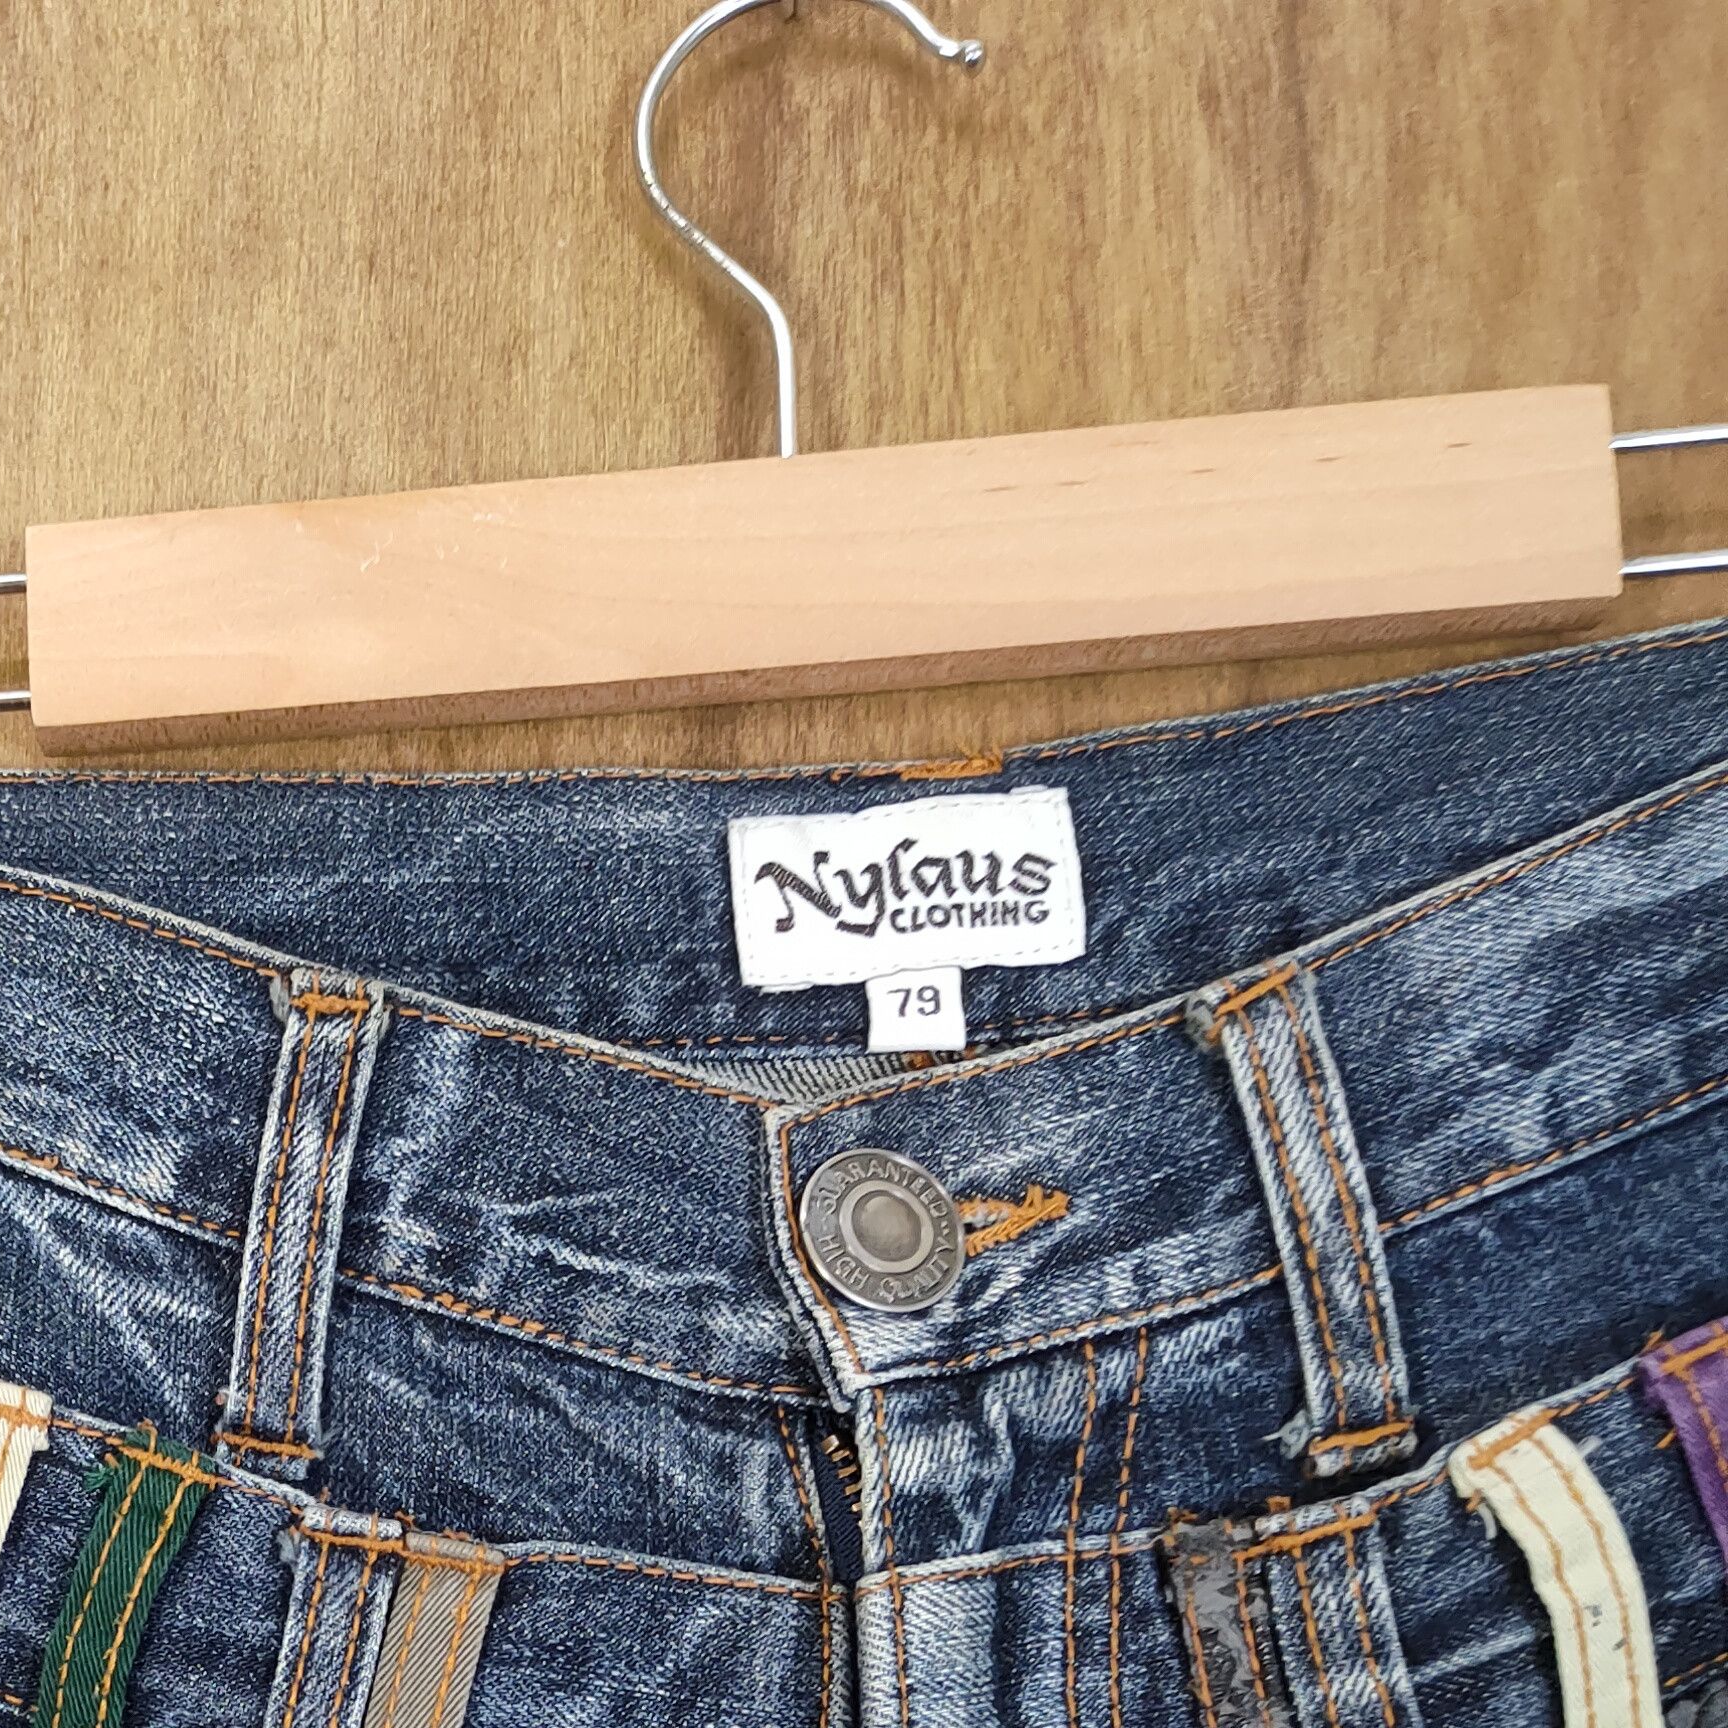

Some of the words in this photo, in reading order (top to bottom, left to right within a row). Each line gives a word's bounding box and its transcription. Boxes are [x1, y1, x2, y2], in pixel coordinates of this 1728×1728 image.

[754, 838, 1059, 938] Nylaus
[890, 900, 1050, 934] CLOTHING
[887, 985, 942, 1018] 79
